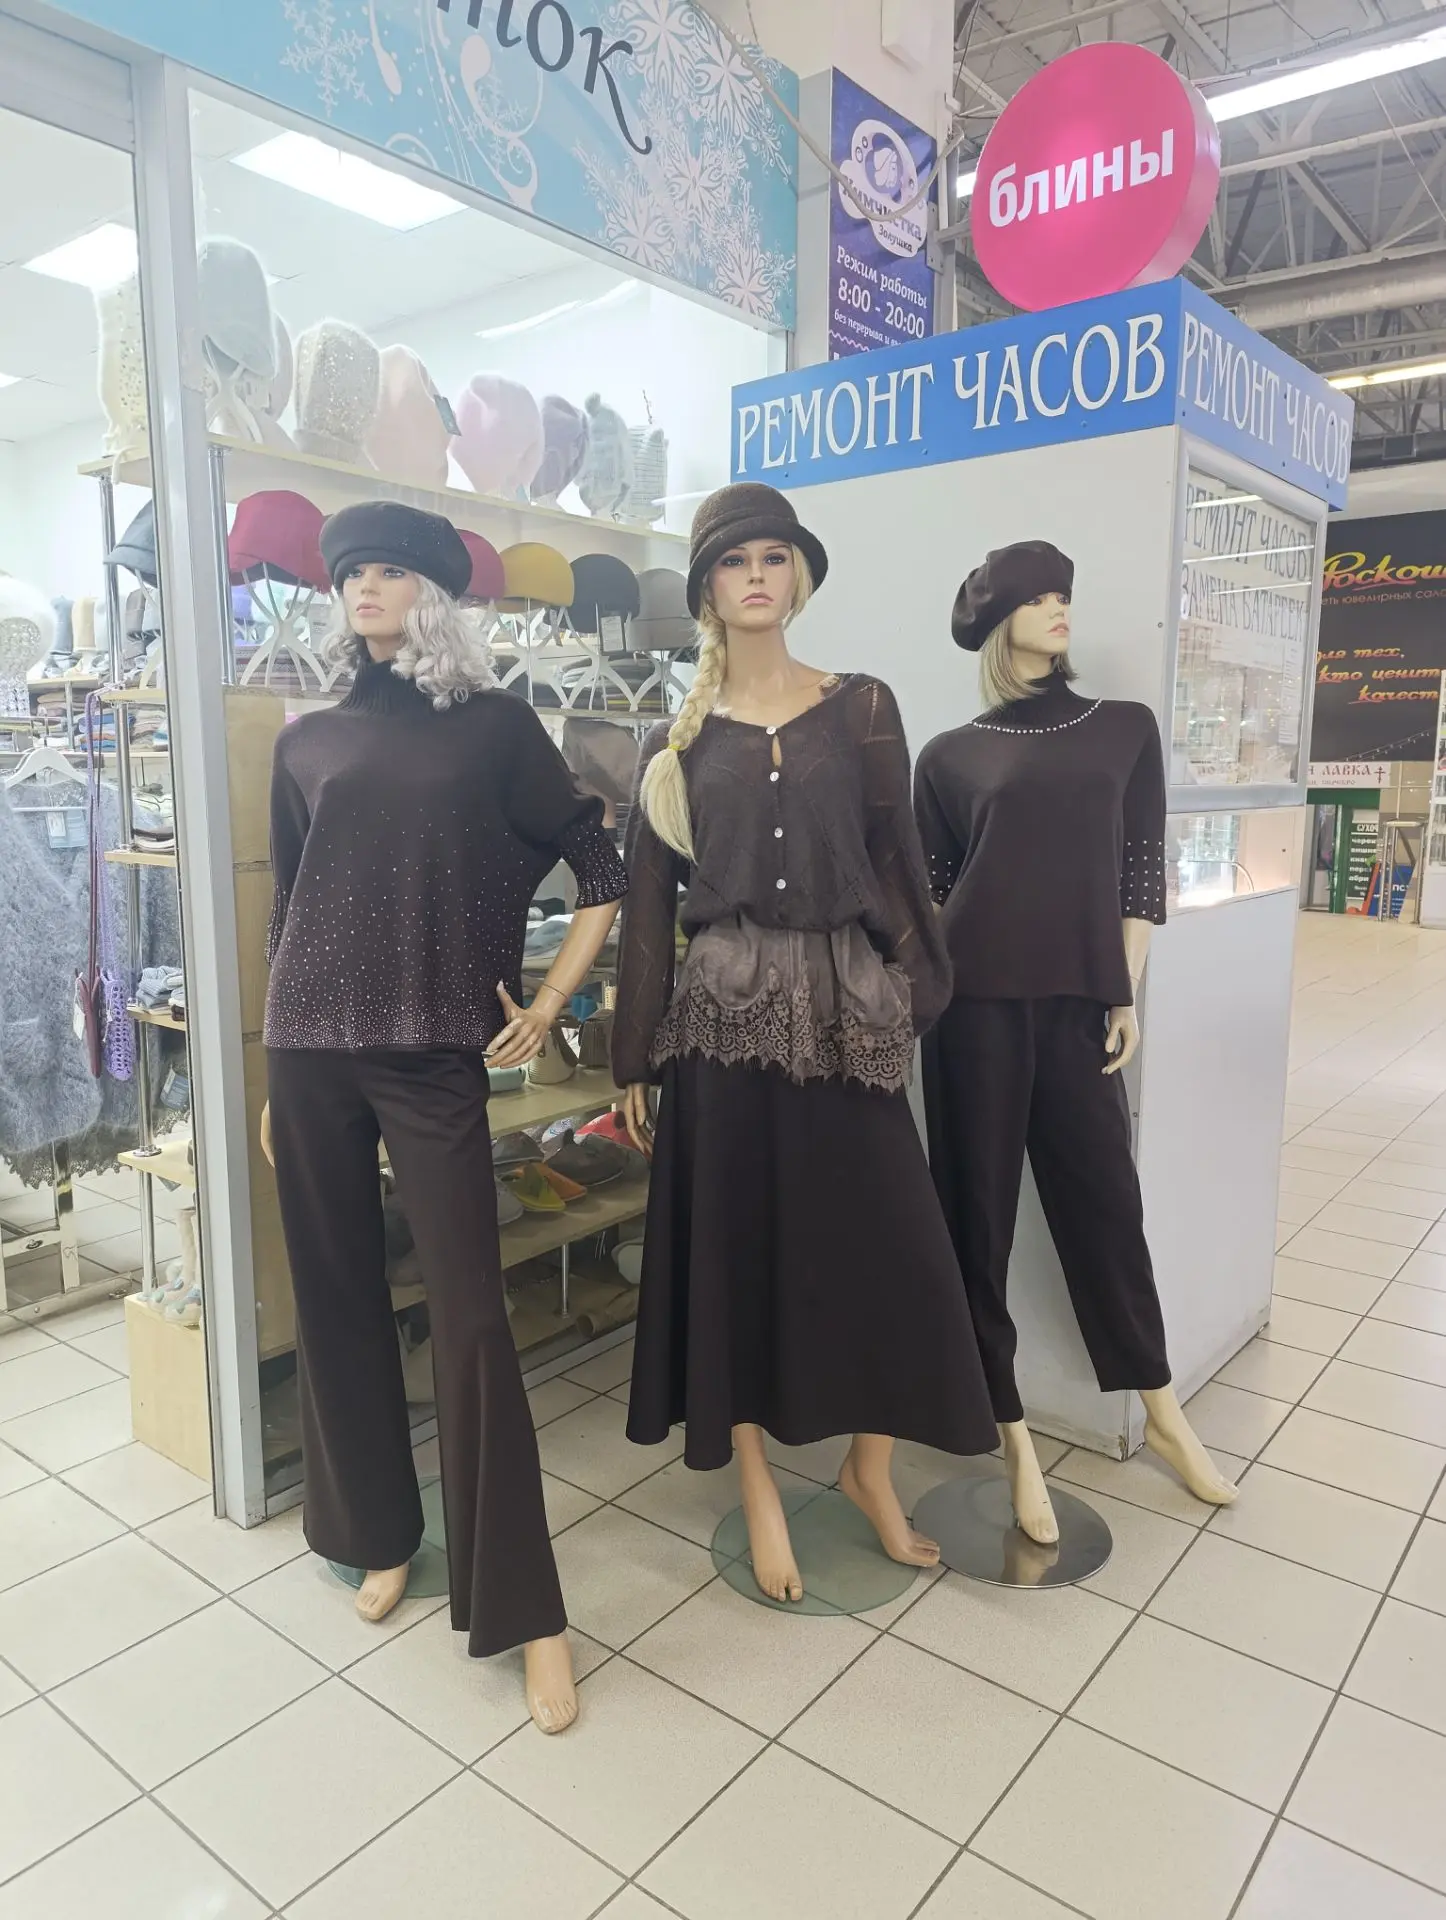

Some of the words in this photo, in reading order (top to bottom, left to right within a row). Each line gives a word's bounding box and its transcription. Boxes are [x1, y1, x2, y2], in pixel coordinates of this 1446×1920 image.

[989, 129, 1174, 228] блины
[879, 224, 913, 253] Золушка
[836, 245, 878, 283] Режим
[880, 274, 927, 309] работы
[838, 277, 871, 312] 8:00
[884, 302, 925, 338] 20:00
[834, 309, 847, 324] без
[848, 318, 883, 342] перерыва
[737, 363, 934, 474] РЕМОНТ
[953, 314, 1165, 430] ЧАСОВ
[1178, 312, 1279, 446] РЕМОНТ
[1287, 383, 1350, 484] ЧАСОВ
[1184, 482, 1257, 565] РЕМОНТ
[1260, 515, 1307, 581] ЧАСОВ
[1182, 564, 1238, 628] ЗАМЕНА
[1321, 595, 1338, 606] еть
[1343, 591, 1411, 604] ювелирных
[1316, 665, 1363, 685] кто
[1372, 668, 1441, 681] ценит
[1322, 765, 1372, 777] ЛАВКА
